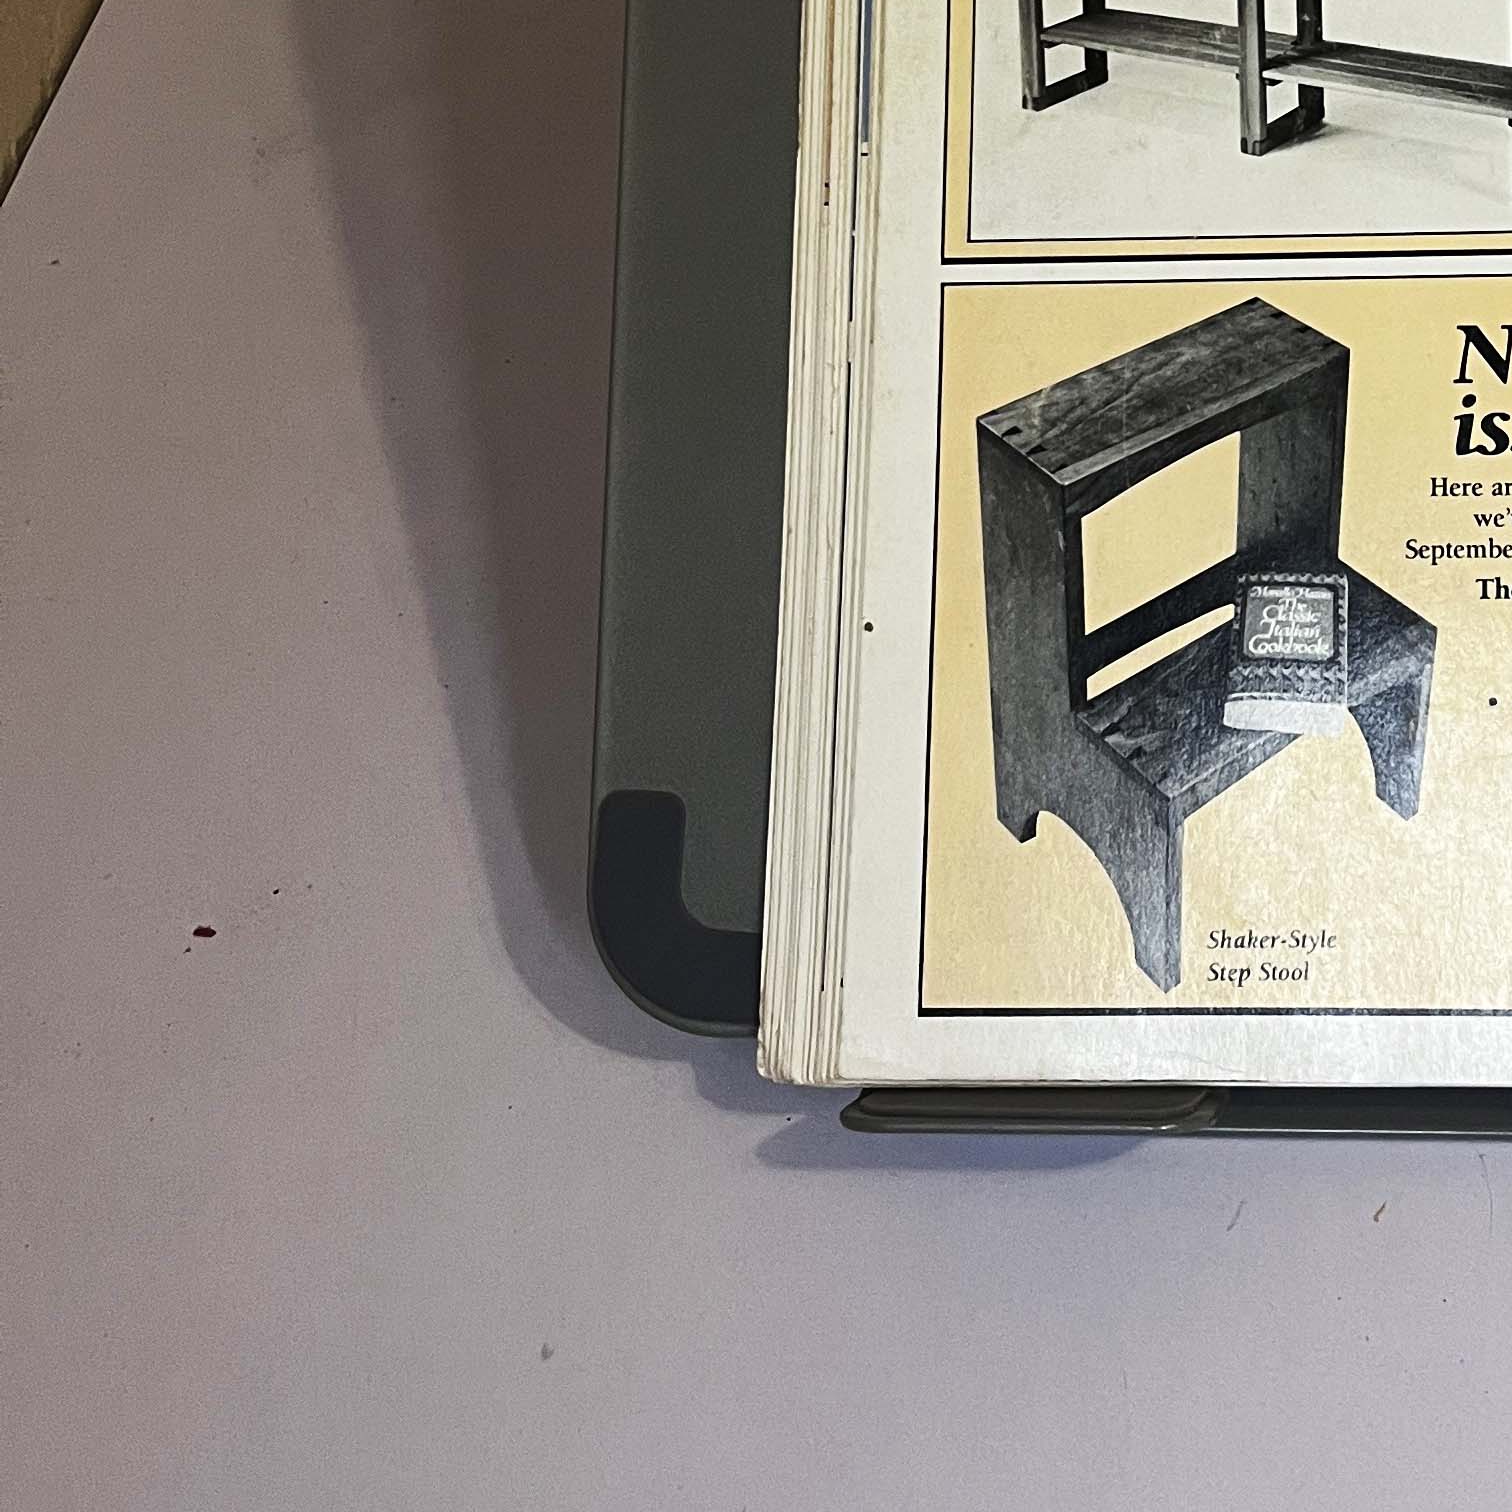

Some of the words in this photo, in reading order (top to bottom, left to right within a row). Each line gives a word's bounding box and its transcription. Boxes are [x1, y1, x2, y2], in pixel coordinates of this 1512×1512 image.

[1431, 477, 1483, 496] Here
[1206, 929, 1338, 953] Shaker-Style
[1206, 962, 1252, 986] Step
[1259, 962, 1309, 982] Stool
